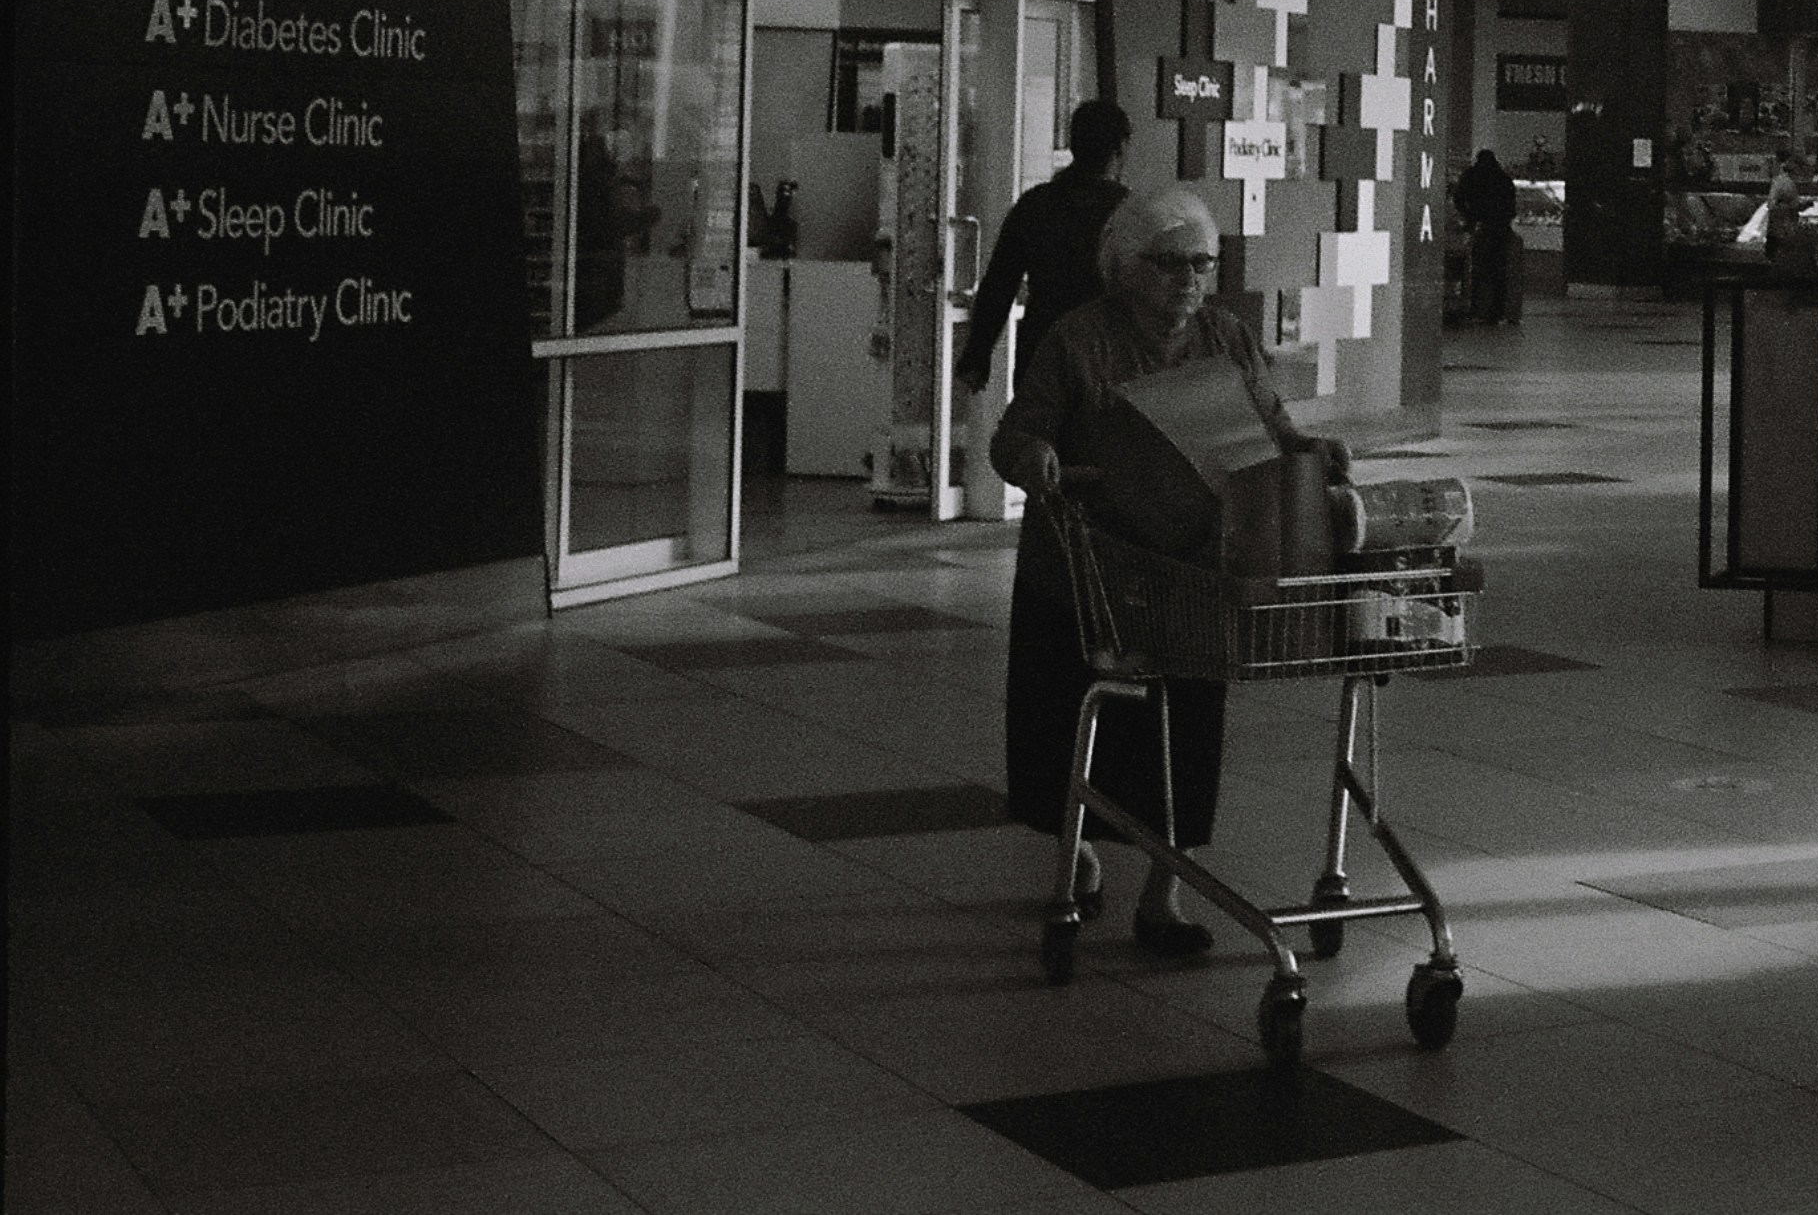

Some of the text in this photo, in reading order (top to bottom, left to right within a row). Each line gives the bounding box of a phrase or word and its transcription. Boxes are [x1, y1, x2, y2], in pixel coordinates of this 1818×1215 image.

[349, 9, 427, 61] Clinic
[201, 94, 296, 145] Nurse
[304, 98, 384, 147] Clinic
[197, 187, 286, 256] Sleep
[294, 189, 374, 238] Clinic
[196, 280, 328, 343] Podiatry
[334, 277, 413, 326] Clinic
